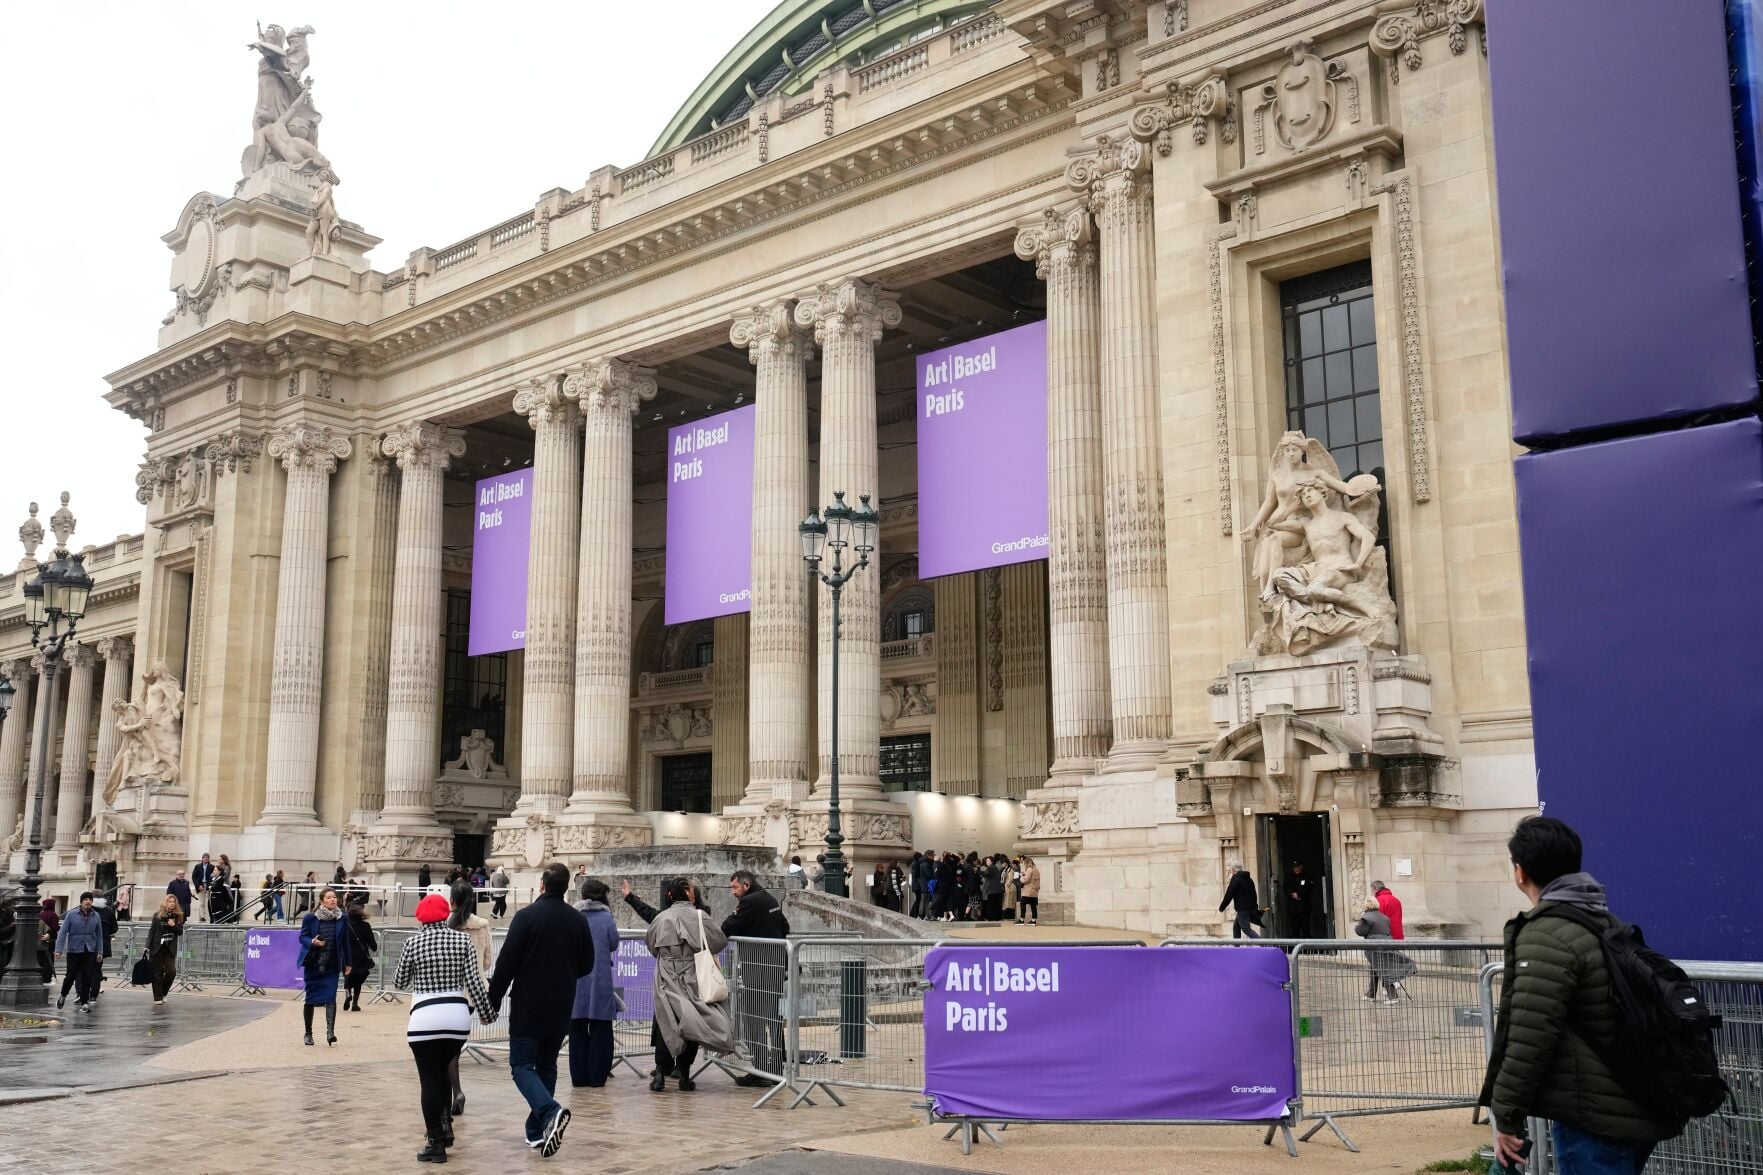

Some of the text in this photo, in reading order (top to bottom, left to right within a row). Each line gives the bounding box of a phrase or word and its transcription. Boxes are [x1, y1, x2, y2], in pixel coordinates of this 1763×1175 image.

[925, 388, 965, 418] Paris
[673, 458, 703, 483] Paris
[479, 508, 503, 530] Paris
[247, 948, 261, 959] Paris
[617, 961, 638, 977] Paris
[945, 1001, 1008, 1032] Paris
[1231, 1085, 1277, 1095] GrandPalais
